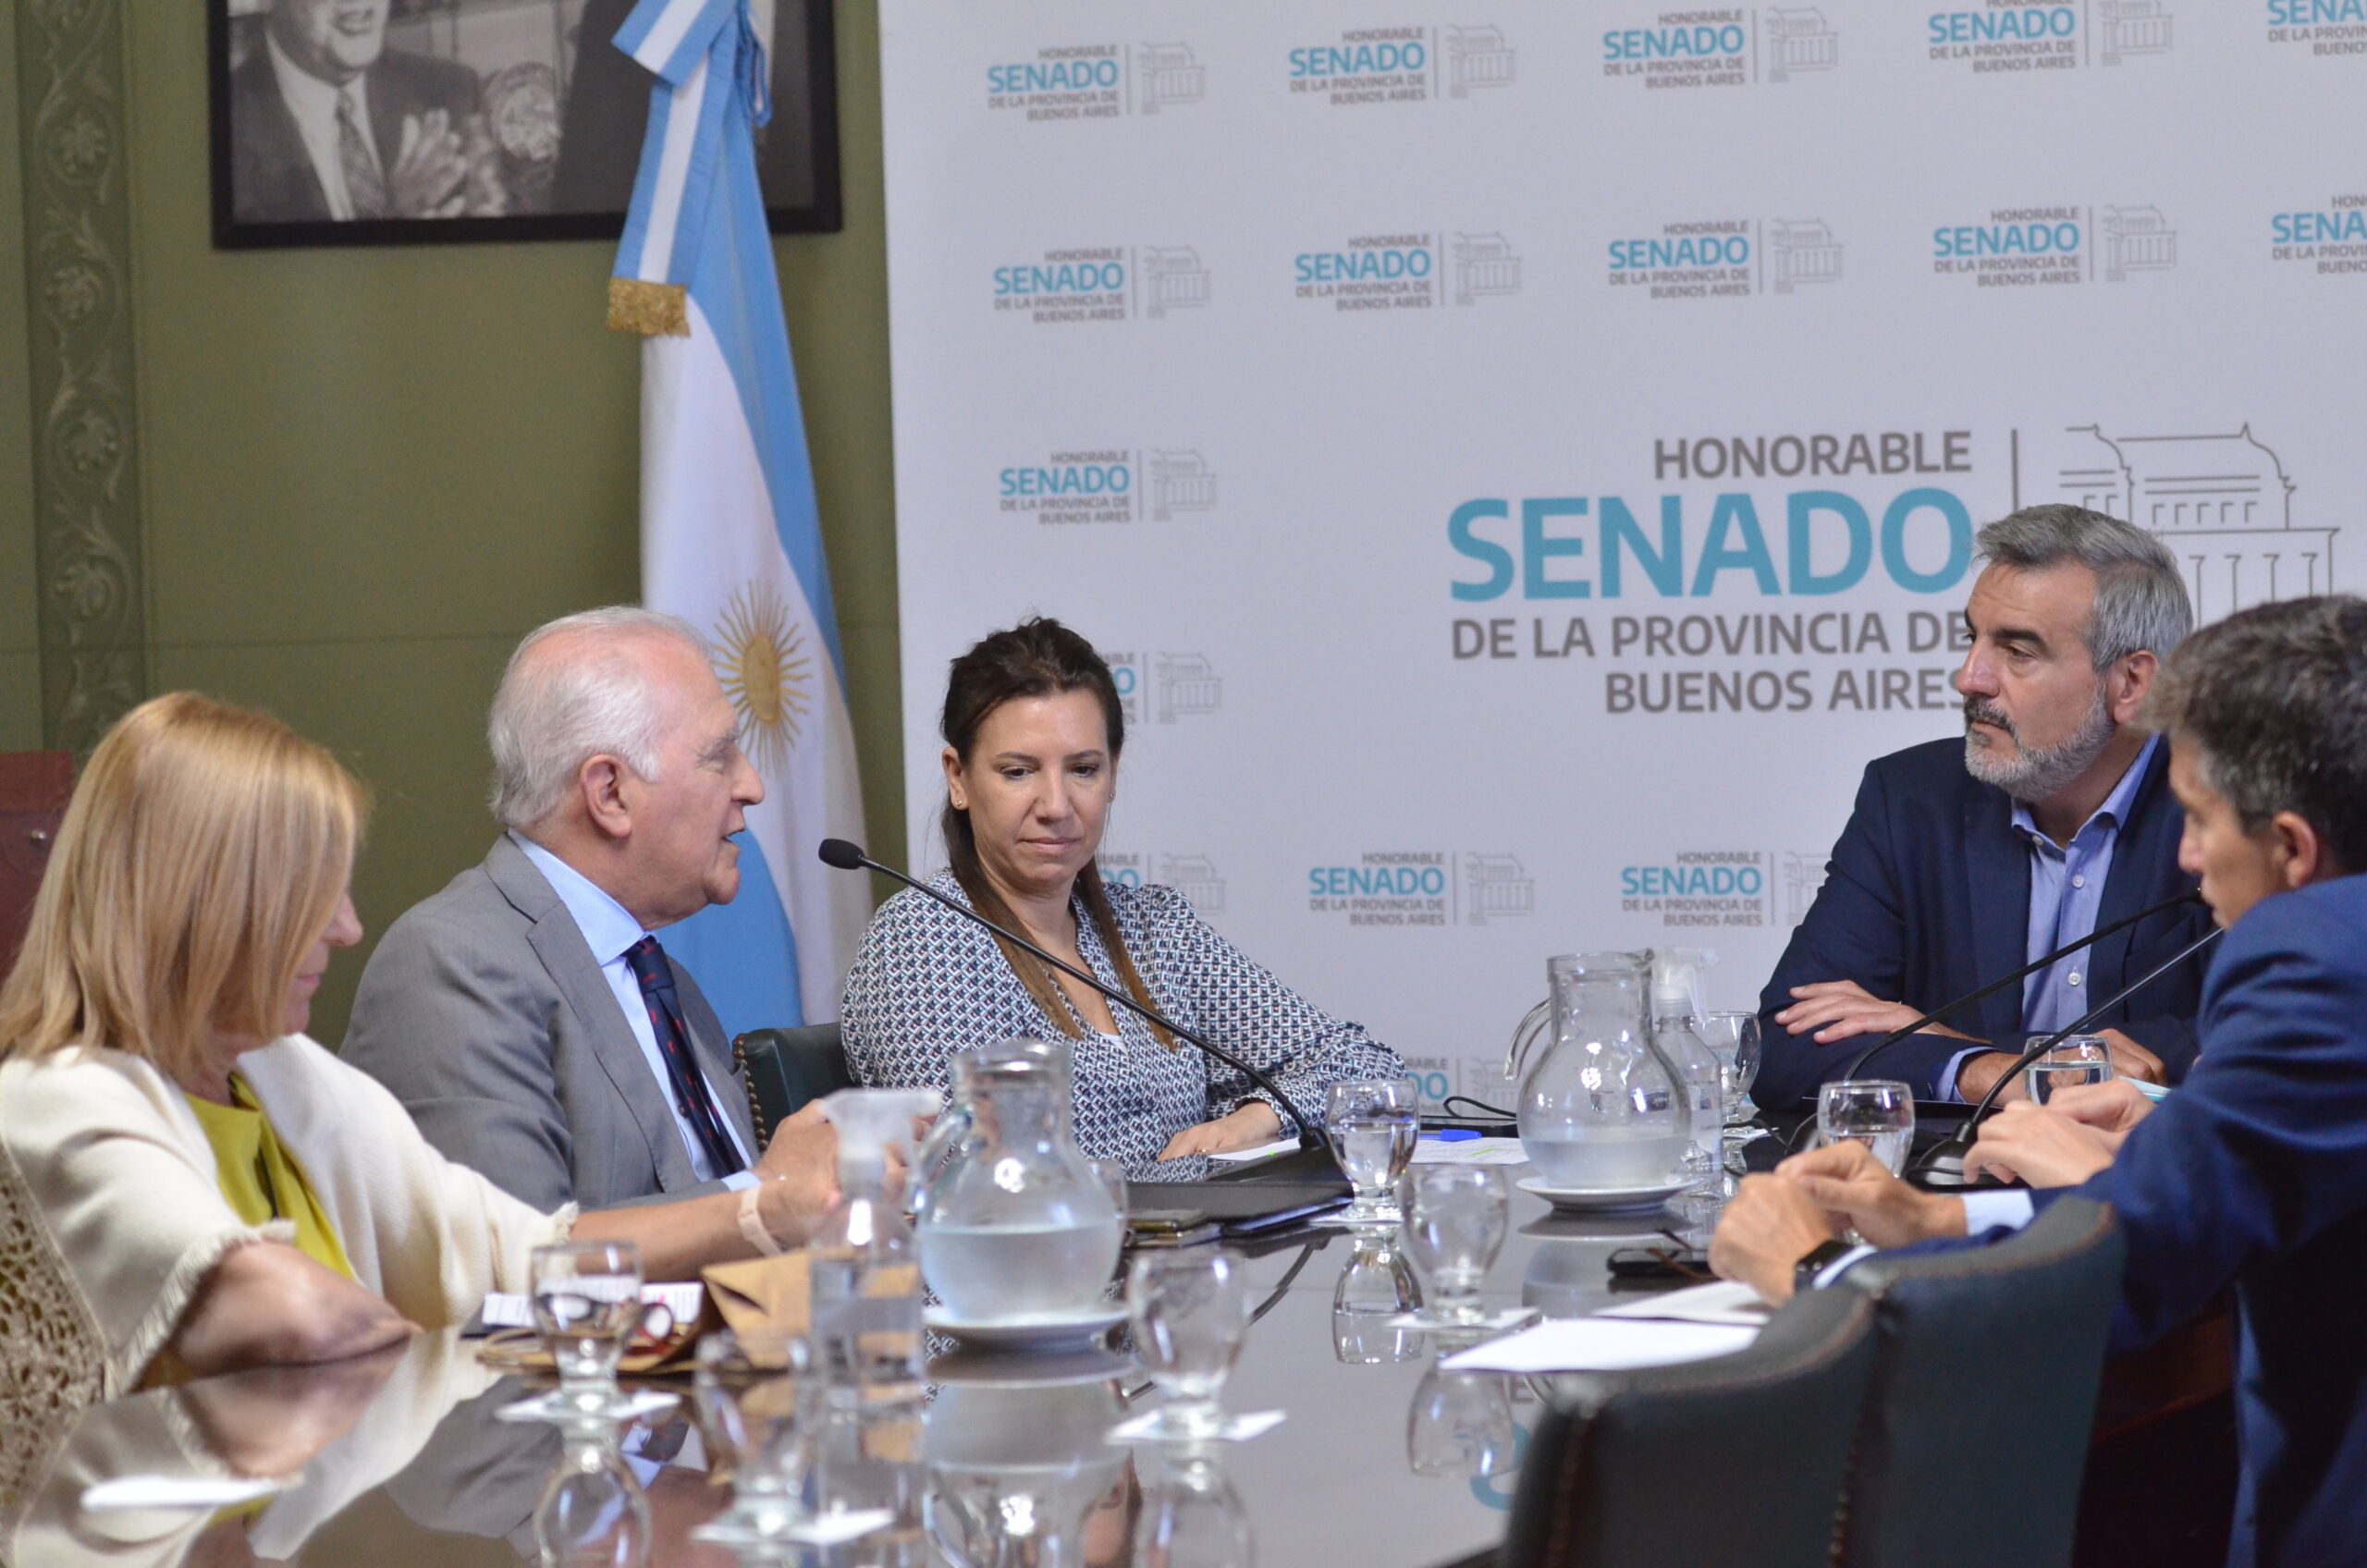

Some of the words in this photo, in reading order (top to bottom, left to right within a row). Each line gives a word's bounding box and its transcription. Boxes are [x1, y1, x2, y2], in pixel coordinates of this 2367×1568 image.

[1658, 8, 1743, 26] HONORABLE
[2267, 0, 2367, 26] SENA
[1929, 6, 2076, 43] SENADO
[1342, 26, 1424, 43] HONORABLE
[1602, 24, 1745, 60] SENADO
[2268, 28, 2288, 43] DE
[2291, 28, 2312, 42] LA
[1037, 43, 1117, 60] HONORABLE
[1929, 45, 1949, 60] DE
[1952, 44, 1971, 59] LA
[1974, 41, 2054, 57] PROVINCIA
[2055, 40, 2076, 54] DE
[2312, 41, 2367, 56] BUENO
[1289, 41, 1426, 78] SENADO
[1603, 62, 1623, 76] DE
[1625, 62, 1644, 75] LA
[1647, 58, 1723, 74] PROVINCIA
[1725, 56, 1746, 71] DE
[1972, 57, 2032, 73] BUENOS
[2034, 55, 2077, 69] AIRES
[987, 57, 1119, 94] SENADO
[1290, 79, 1308, 93] DE
[1310, 79, 1330, 92] LA
[1331, 74, 1405, 91] PROVINCIA
[1406, 72, 1426, 87] DE
[1645, 73, 1703, 90] BUENOS
[1705, 71, 1746, 86] AIRES
[987, 95, 1006, 109] DE
[1007, 94, 1026, 108] LA
[1026, 91, 1099, 108] PROVINCIA
[1100, 90, 1119, 104] DE
[1330, 90, 1386, 105] BUENOS
[1386, 87, 1427, 102] AIRES
[1026, 106, 1081, 122] BUENOS
[1081, 104, 1120, 118] AIRES
[1991, 206, 2079, 223] HONORABLE
[1663, 220, 1748, 236] HONORABLE
[2272, 210, 2367, 244] SENA
[1348, 233, 1430, 250] HONORABLE
[1933, 221, 2080, 257] SENADO
[1045, 247, 1123, 263] HONORABLE
[1608, 235, 1749, 270] SENADO
[2272, 246, 2292, 261] DE
[2296, 245, 2315, 259] LA
[2318, 243, 2367, 259] PROVI
[1294, 248, 1431, 283] SENADO
[1934, 259, 1954, 274] DE
[1956, 259, 1976, 273] LA
[1979, 255, 2057, 272] PROVINCIA
[2060, 254, 2080, 269] DE
[2317, 258, 2367, 275] BUENO
[993, 261, 1124, 296] SENADO
[1609, 272, 1627, 286] DE
[1630, 271, 1650, 285] LA
[1651, 268, 1727, 285] PROVINCIA
[1730, 267, 1749, 282] DE
[1977, 272, 2037, 287] BUENOS
[2039, 270, 2081, 284] AIRES
[1295, 284, 1314, 298] DE
[1317, 284, 1335, 298] LA
[1337, 281, 1411, 297] PROVINCIA
[1413, 279, 1432, 294] DE
[1650, 284, 1708, 300] BUENOS
[1710, 282, 1750, 297] AIRES
[994, 297, 1012, 311] DE
[1013, 296, 1032, 310] LA
[1034, 292, 1105, 310] PROVINCIA
[1105, 292, 1125, 307] DE
[1336, 295, 1391, 312] BUENOS
[1392, 293, 1432, 309] AIRES
[1033, 308, 1086, 324] BUENOS
[1086, 307, 1126, 321] AIRES
[1050, 449, 1129, 464] HONORABLE
[1654, 431, 1972, 481] HONORABLE
[1000, 463, 1130, 497] SENADO
[1000, 497, 1017, 511] DE
[1020, 498, 1038, 511] LA
[1039, 496, 1110, 511] PROVINCIA
[1112, 495, 1131, 509] DE
[1038, 510, 1091, 525] BUENOS
[1094, 508, 1132, 523] AIRES
[1447, 487, 1973, 603] SENADO
[1452, 618, 1517, 660] DE
[1533, 617, 1596, 658] LA
[1612, 612, 1891, 657] PROVINCIA
[1907, 611, 1971, 654] DE
[1605, 669, 1813, 715] BUENOS
[1362, 851, 1444, 866] HONORABLE
[1676, 851, 1760, 865] HONORABLE
[1308, 866, 1444, 896] SENADO
[1621, 866, 1762, 896] SENADO
[1309, 898, 1329, 912] DE
[1331, 899, 1349, 911] LA
[1351, 898, 1424, 912] PROVINCIA
[1426, 898, 1445, 912] DE
[1622, 898, 1640, 912] DE
[1643, 898, 1662, 912] LA
[1664, 898, 1740, 912] PROVINCIA
[1743, 899, 1762, 912] DE
[1349, 913, 1404, 926] BUENOS
[1406, 913, 1445, 926] AIRES
[1663, 913, 1720, 926] BUENOS
[1723, 913, 1762, 926] AIRES
